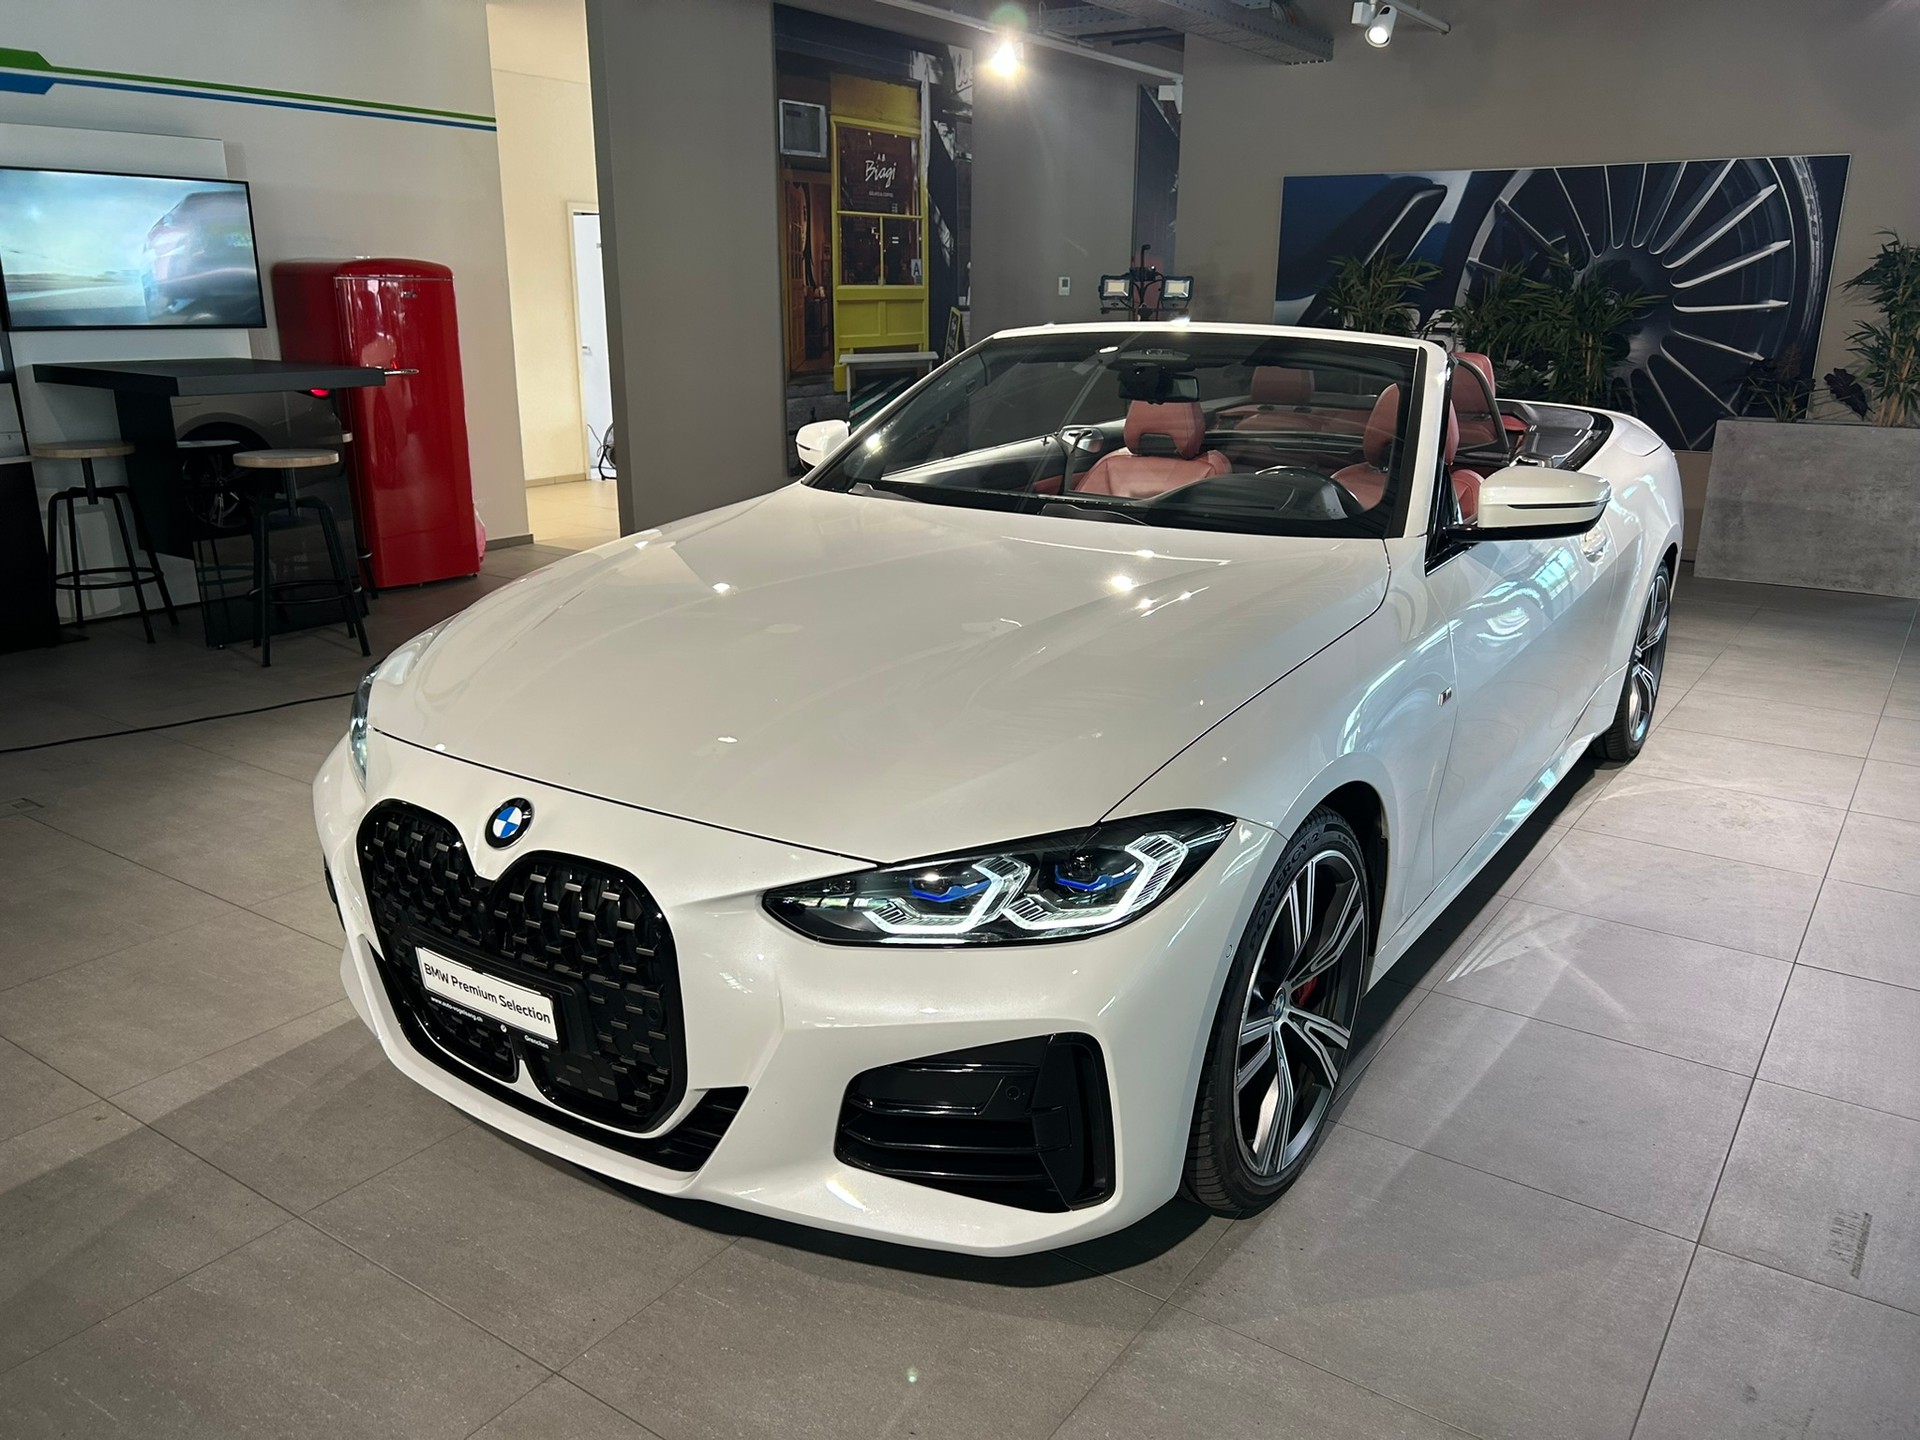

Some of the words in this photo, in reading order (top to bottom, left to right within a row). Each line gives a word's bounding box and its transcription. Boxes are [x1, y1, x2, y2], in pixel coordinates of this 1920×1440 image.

[865, 160, 896, 188] Biagi
[913, 262, 921, 276] A
[1249, 842, 1309, 951] POWERGY
[1312, 832, 1320, 844] 2
[424, 962, 449, 985] BMW
[451, 975, 498, 1004] Premium
[499, 994, 551, 1024] Selection
